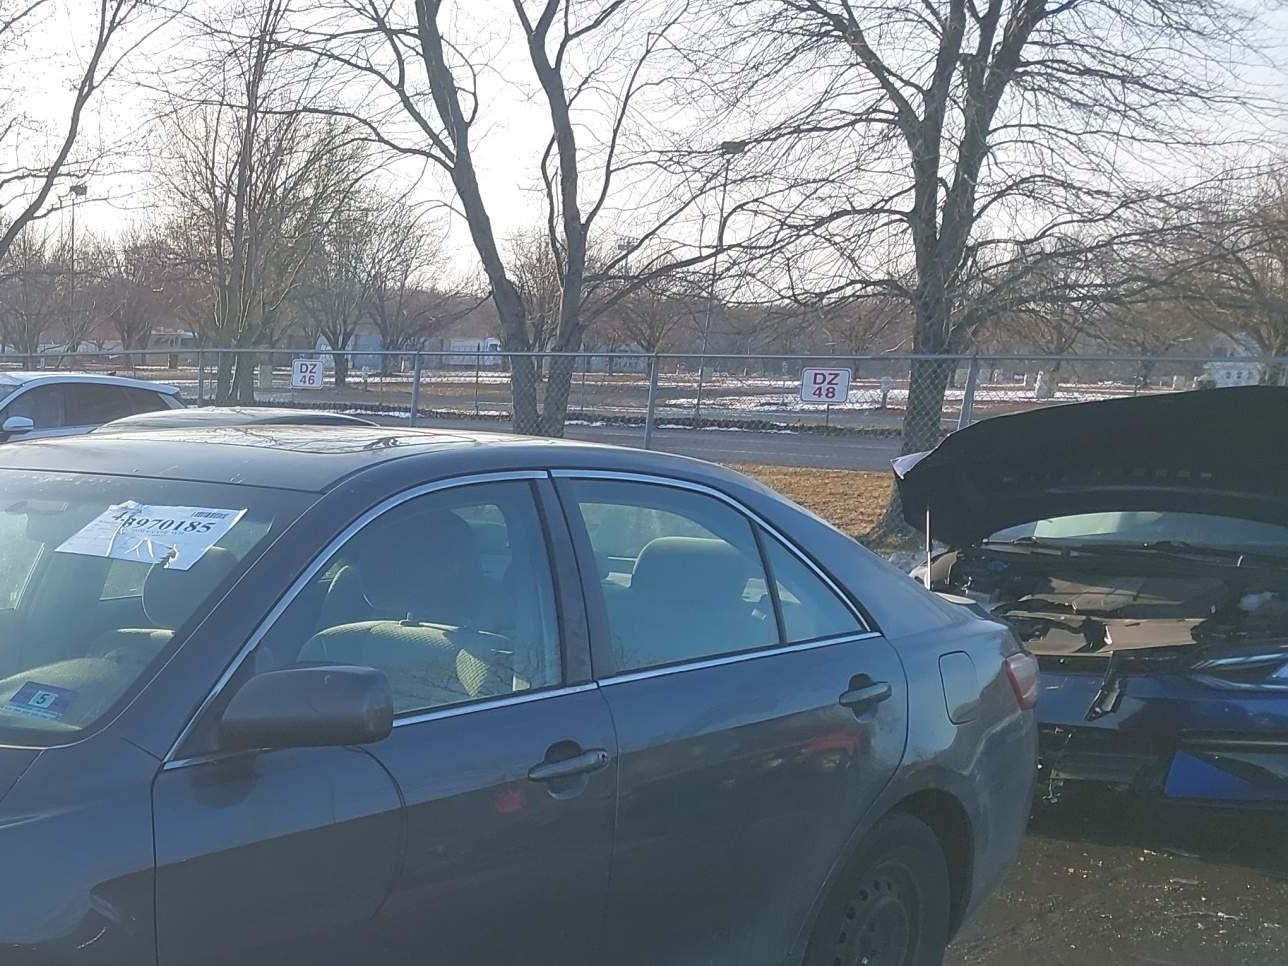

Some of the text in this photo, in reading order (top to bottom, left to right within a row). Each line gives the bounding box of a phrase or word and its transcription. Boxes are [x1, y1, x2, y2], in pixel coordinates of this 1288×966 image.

[300, 363, 317, 374] DZ
[300, 375, 316, 385] 46
[813, 372, 841, 386] DZ
[812, 386, 836, 399] 48
[36, 693, 51, 705] 5
